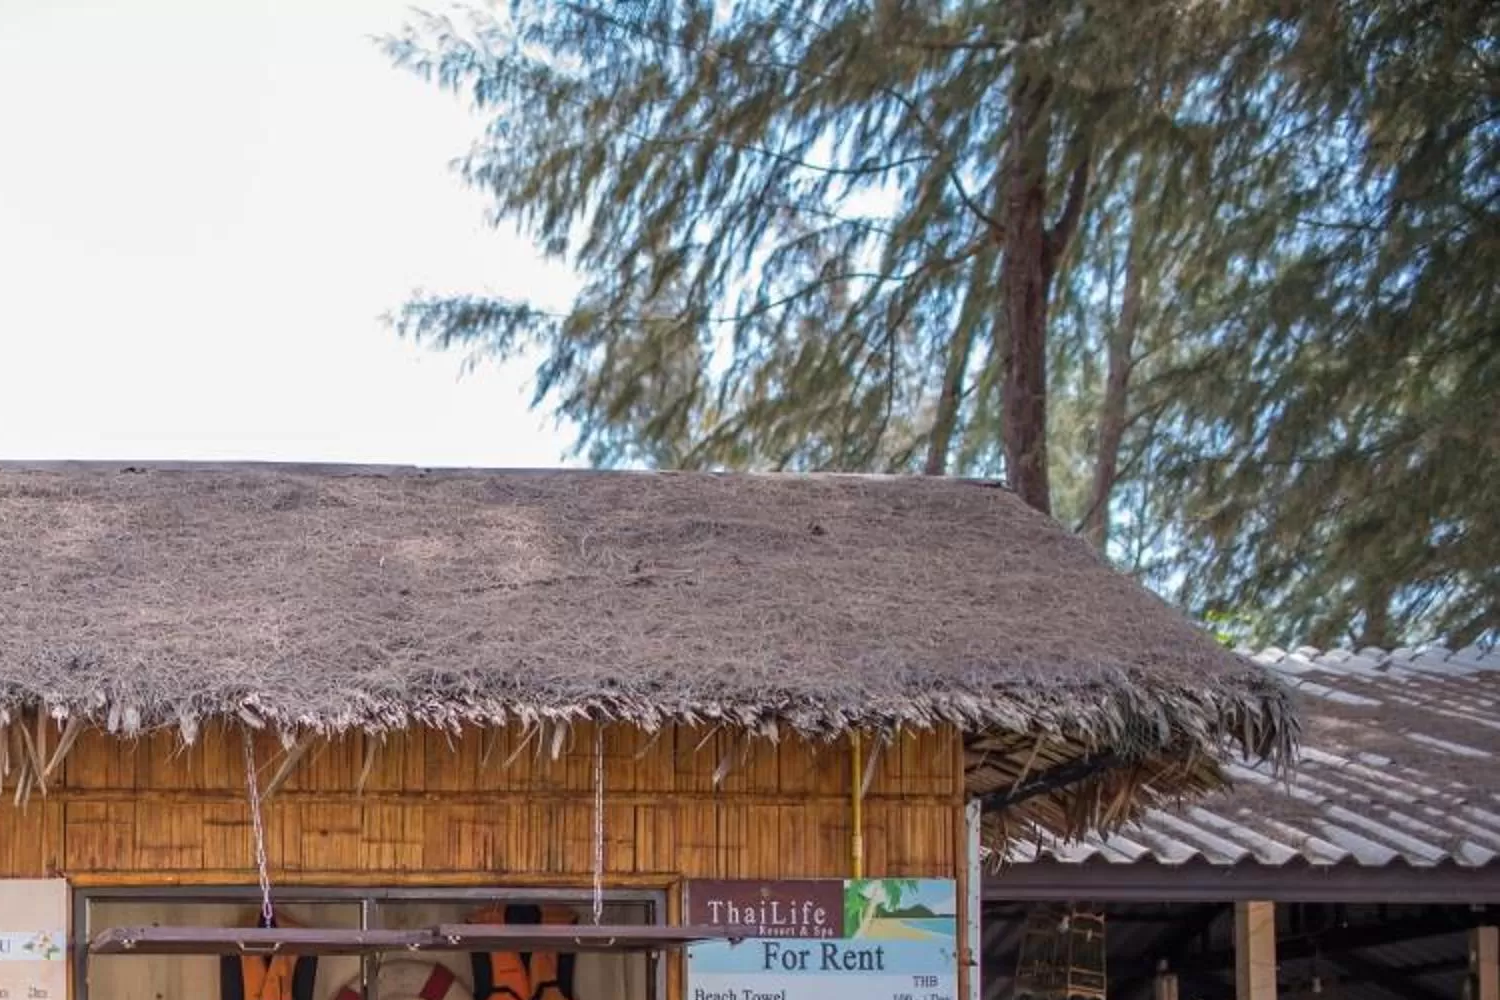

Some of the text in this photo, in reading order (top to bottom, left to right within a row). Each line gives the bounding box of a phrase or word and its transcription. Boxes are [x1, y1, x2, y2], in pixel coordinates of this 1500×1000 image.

[707, 900, 826, 925] ThaiLife
[759, 925, 834, 939] Resort & Spa
[762, 941, 885, 970] For Rent
[912, 975, 939, 988] THB
